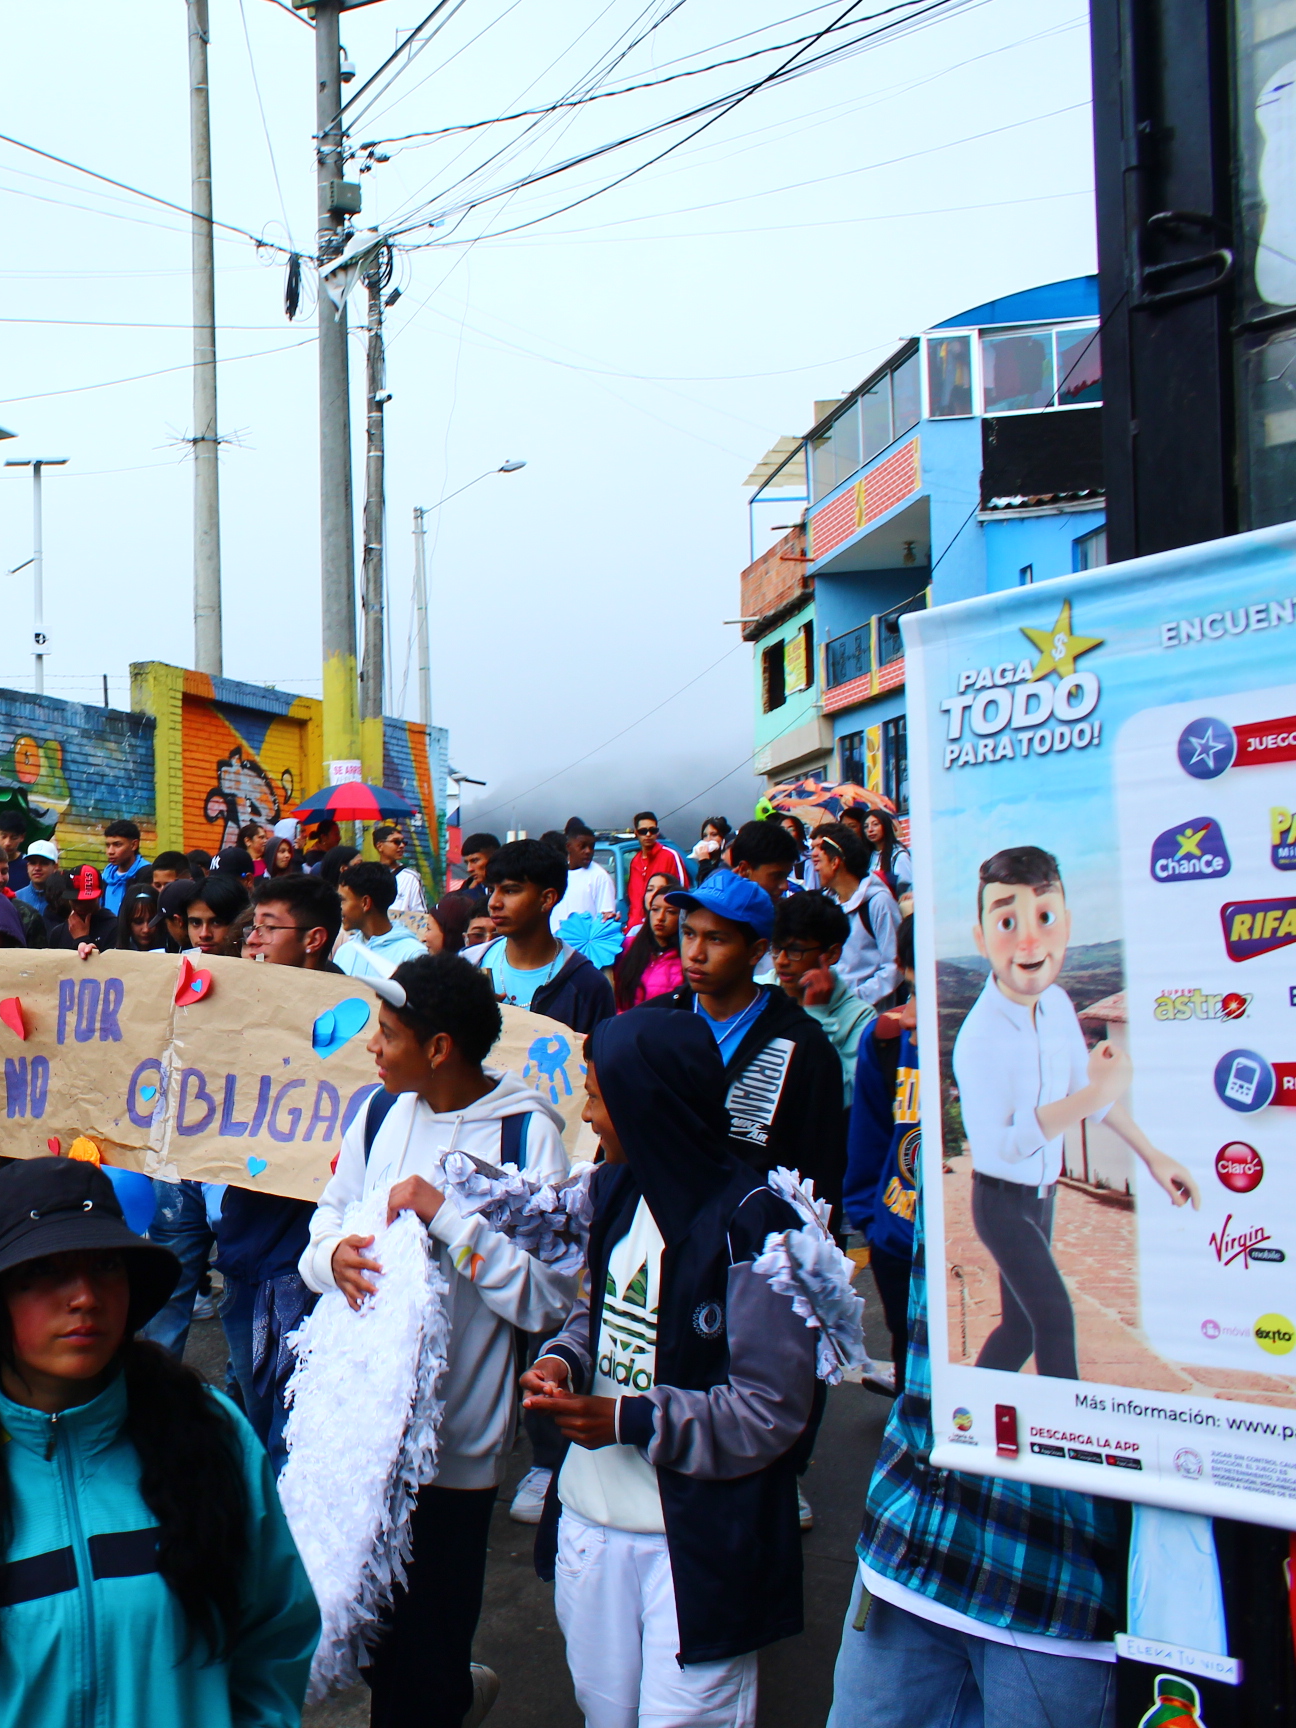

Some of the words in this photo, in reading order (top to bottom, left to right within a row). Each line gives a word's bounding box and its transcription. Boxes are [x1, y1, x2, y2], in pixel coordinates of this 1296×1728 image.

[1161, 598, 1296, 648] ENCUEN
[958, 658, 1034, 695] PAGA
[940, 671, 1101, 741] TODO
[944, 735, 1016, 770] PARA
[1017, 720, 1102, 757] TODO!
[1278, 846, 1296, 858] Mi
[57, 977, 125, 1045] POR
[4, 1054, 49, 1119] NO
[1283, 1077, 1296, 1090] R
[1217, 1157, 1259, 1174] Claro
[1209, 1213, 1271, 1269] Virgin
[1251, 1249, 1281, 1260] mobile
[597, 1350, 653, 1392] dida
[1075, 1393, 1106, 1411] Más
[1111, 1396, 1221, 1427] información:
[1226, 1417, 1296, 1441] www.p
[1030, 1426, 1094, 1447] DESCARGA
[1096, 1437, 1112, 1450] LA
[1115, 1440, 1140, 1453] APP
[1127, 1639, 1172, 1660] ELEVA
